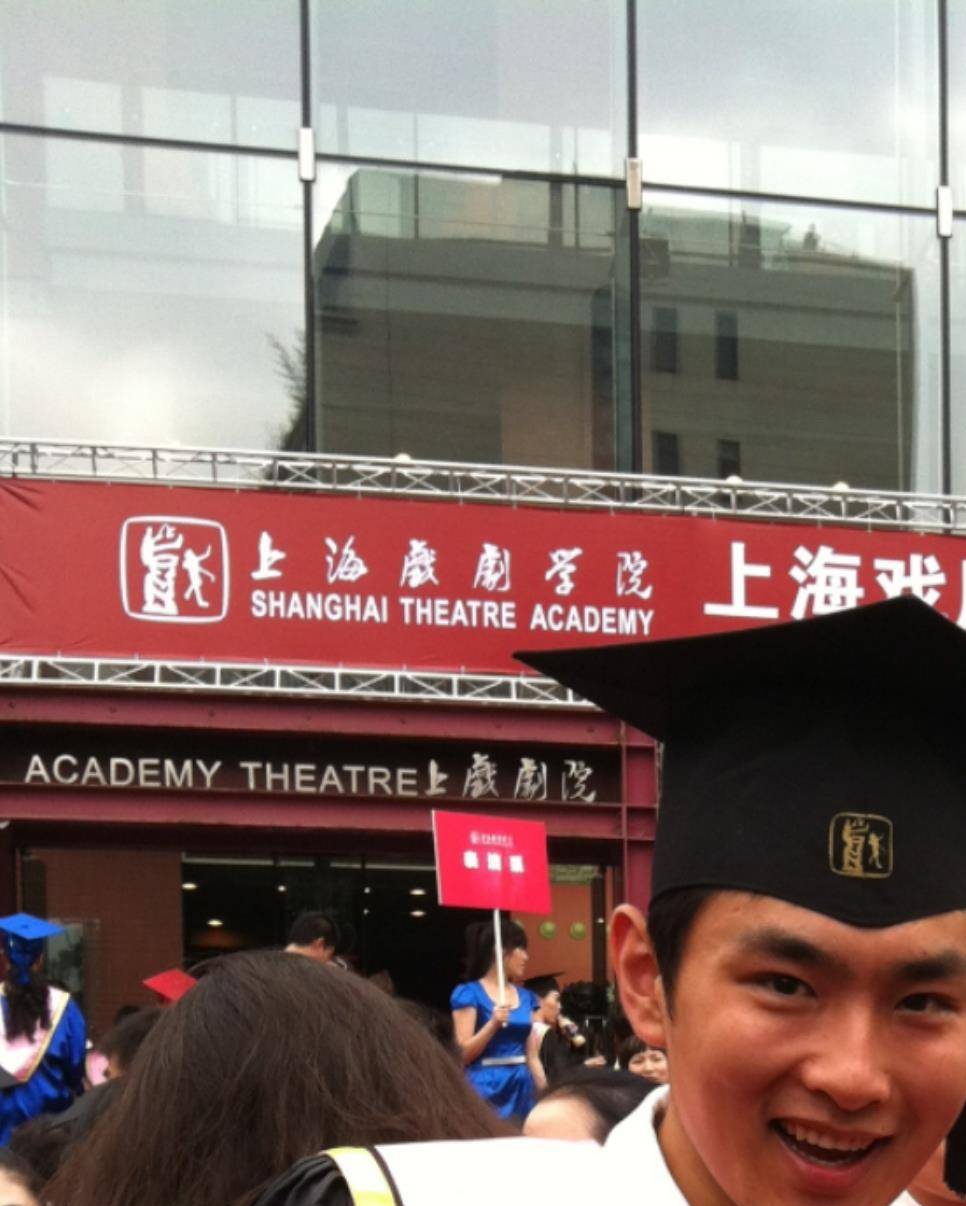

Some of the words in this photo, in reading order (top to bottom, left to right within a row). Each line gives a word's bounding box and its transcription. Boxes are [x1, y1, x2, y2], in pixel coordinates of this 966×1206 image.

[251, 589, 388, 624] SHANGHAI
[400, 597, 517, 630] THEATRE
[529, 603, 655, 636] ACADEMY
[24, 754, 222, 788] ACADEMY
[239, 761, 419, 796] THEATRE
